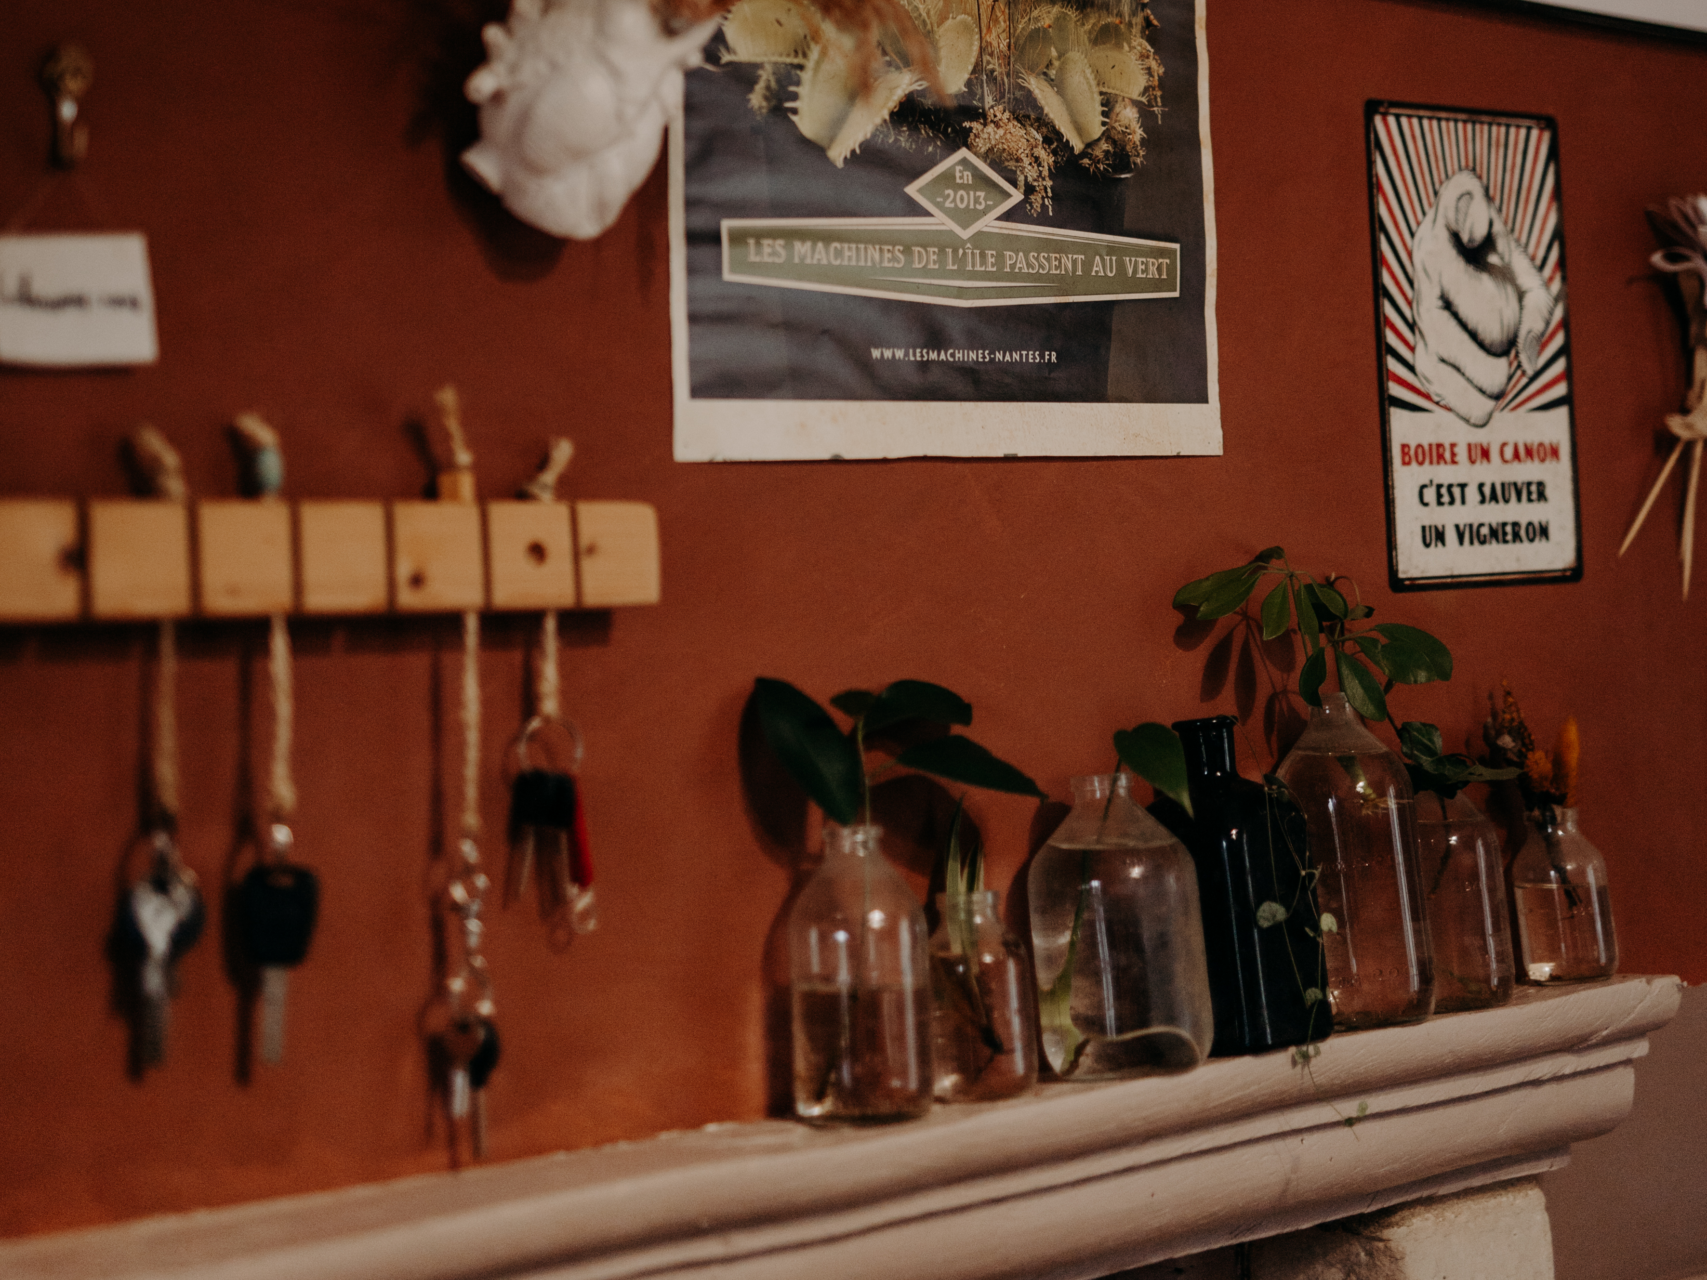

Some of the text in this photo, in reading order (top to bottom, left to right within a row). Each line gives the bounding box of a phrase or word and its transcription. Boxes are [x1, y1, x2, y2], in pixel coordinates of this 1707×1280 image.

[955, 165, 973, 185] En
[747, 238, 1170, 279] LES MACHINES DE L'ÎLE PASSENT AU VERT
[870, 347, 1058, 363] WWW.LESMACHINES-NANTES.FR
[1400, 441, 1561, 466] BOIRE UN CANON
[1418, 479, 1548, 507] C'EST SAUVER
[1421, 520, 1551, 548] UN VIGNERON
